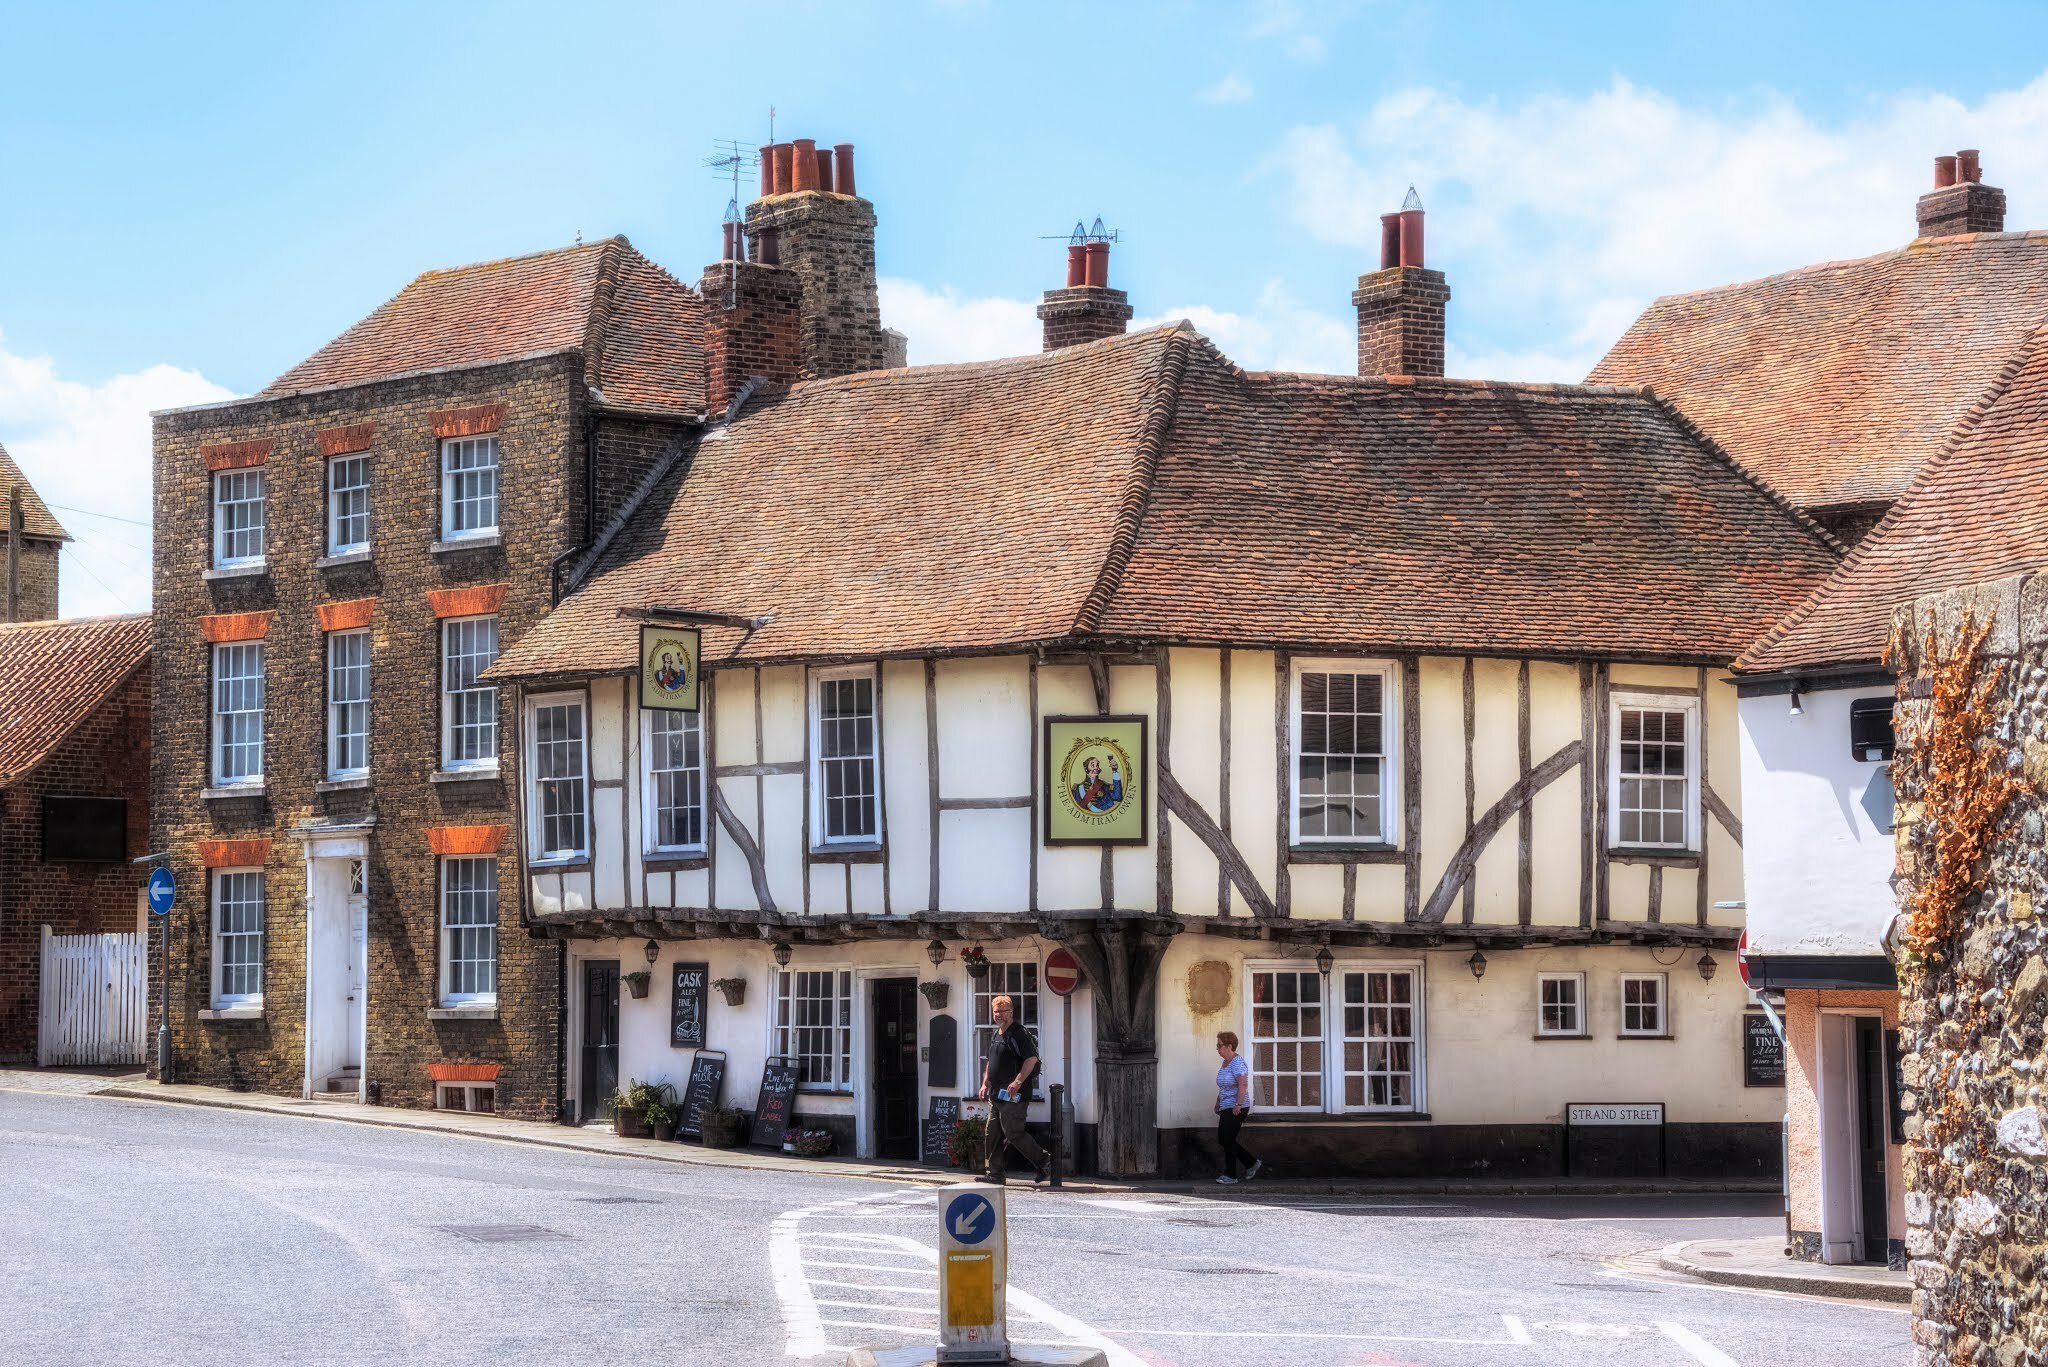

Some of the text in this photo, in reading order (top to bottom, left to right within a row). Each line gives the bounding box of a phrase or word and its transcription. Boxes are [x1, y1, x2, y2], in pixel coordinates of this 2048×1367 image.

[652, 684, 682, 700] ADMIRAL
[682, 673, 694, 694] OWEN
[1057, 784, 1137, 826] THE ADMIRAL OWEN
[677, 972, 702, 987] CASK
[680, 988, 696, 996] ALES
[678, 998, 691, 1007] FINE
[1755, 1036, 1779, 1046] FINE
[697, 1059, 713, 1073] LIVE
[692, 1072, 713, 1081] MUSIC
[768, 1072, 795, 1083] LIVE MUSIC
[764, 1082, 786, 1092] THIS WEEK
[767, 1096, 783, 1110] RED
[938, 1099, 949, 1108] LIVE
[760, 1109, 782, 1121] LABEL
[1572, 1109, 1659, 1120] STRAND STREET
